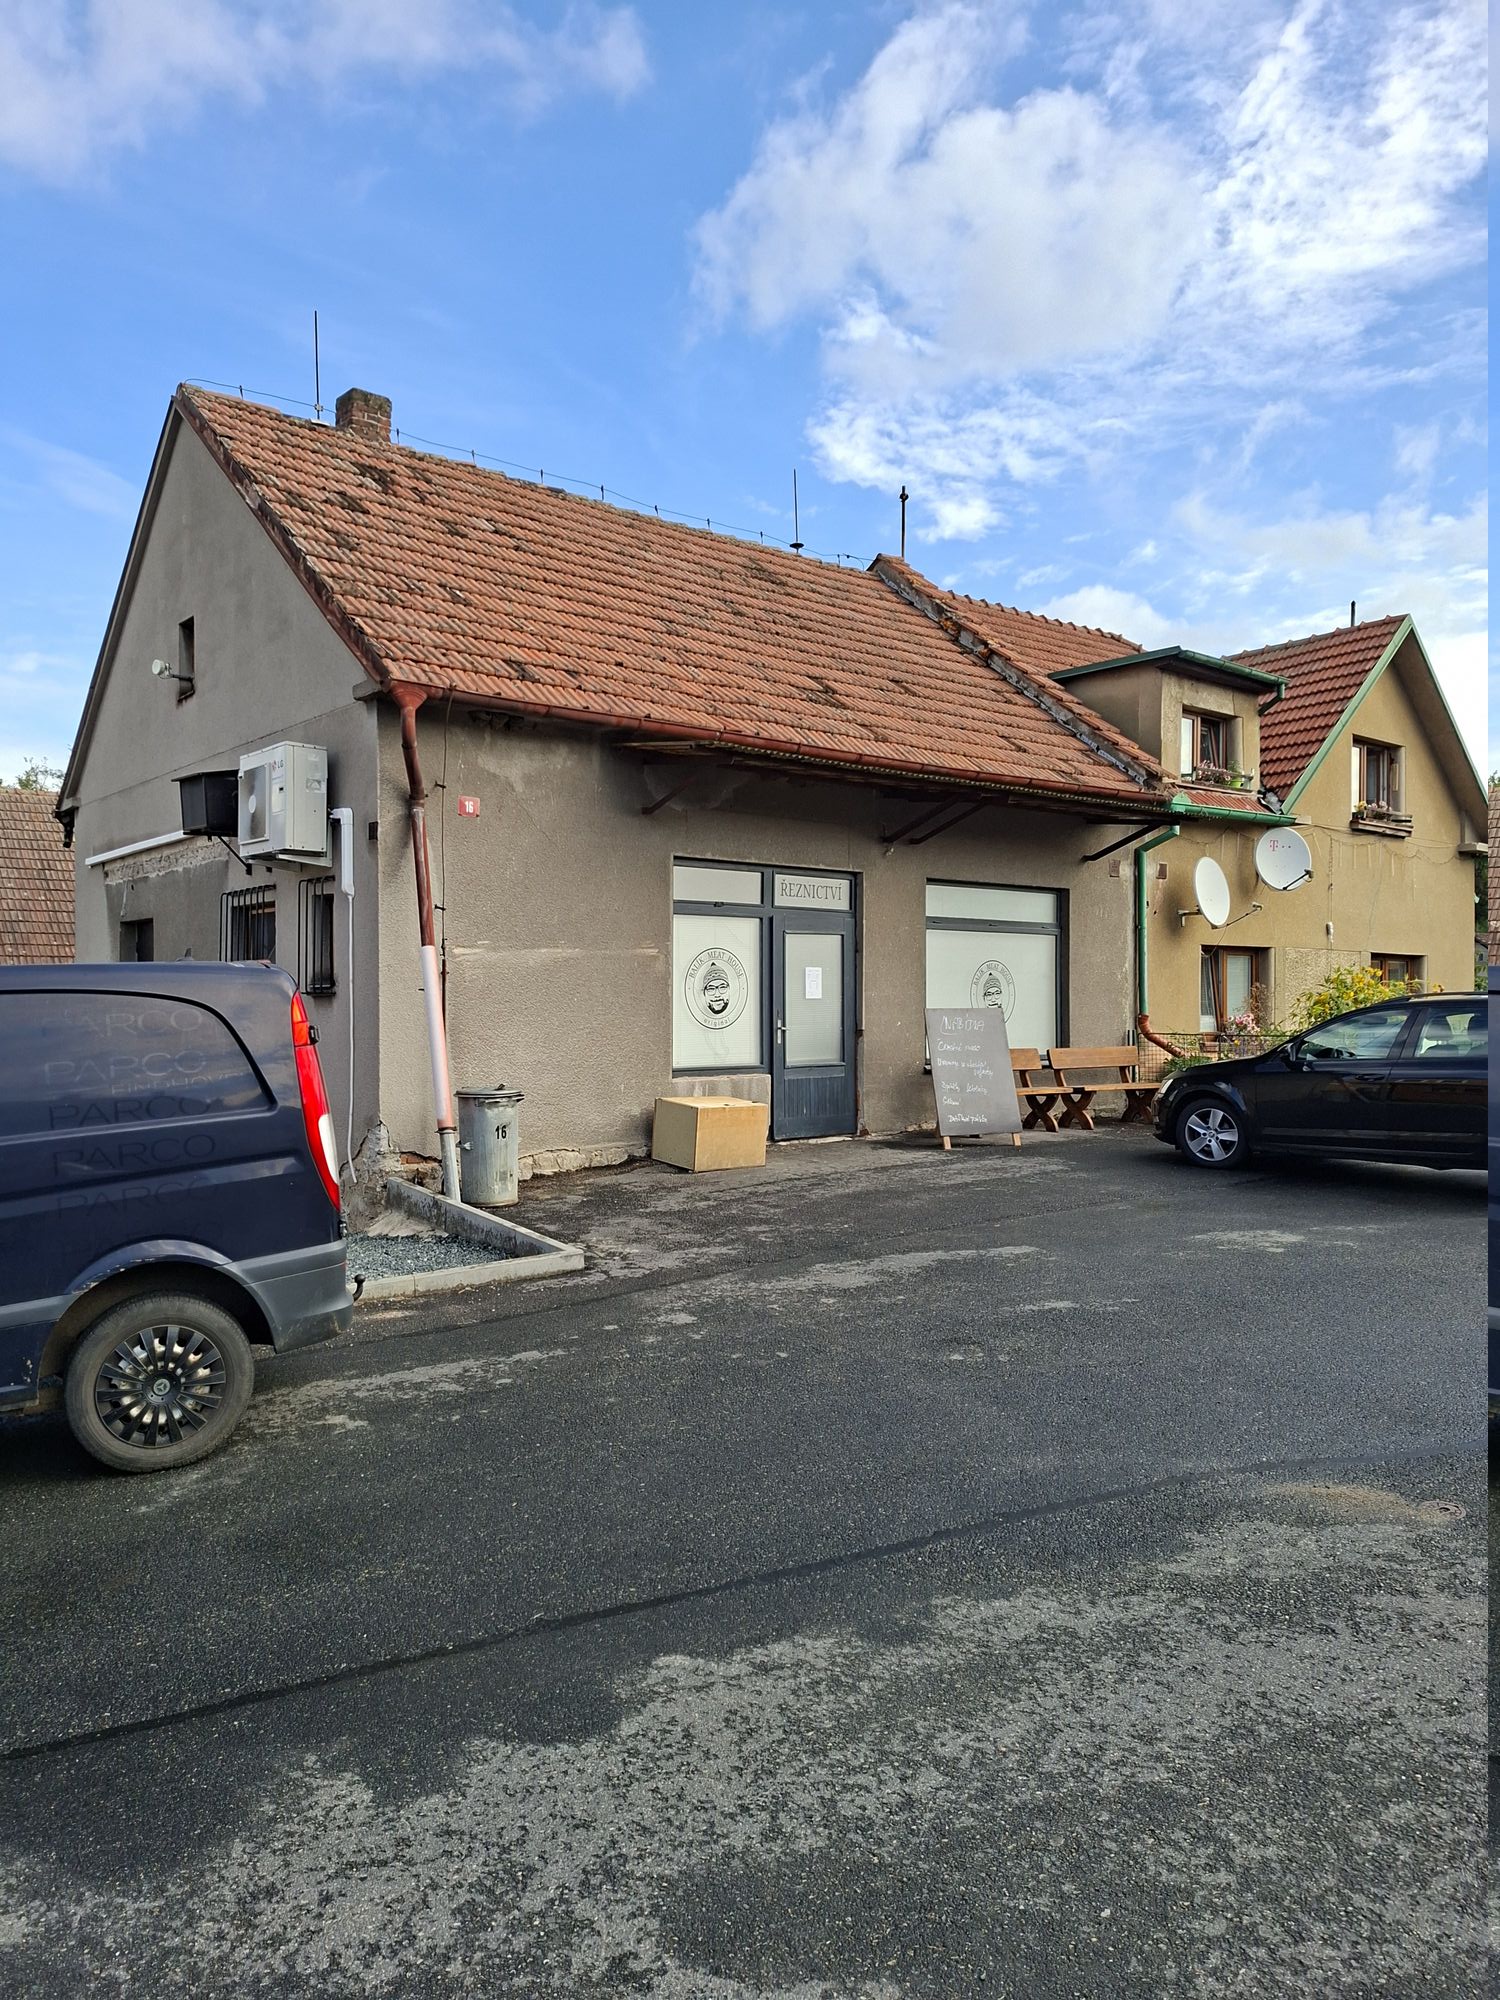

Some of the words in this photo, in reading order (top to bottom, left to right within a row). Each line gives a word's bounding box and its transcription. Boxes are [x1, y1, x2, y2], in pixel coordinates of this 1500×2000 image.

[277, 759, 285, 769] LG
[465, 800, 474, 813] 16
[780, 879, 843, 901] ŘEZNICTVÍ
[707, 950, 725, 960] MEAT
[727, 955, 744, 978] HOUSE
[44, 1051, 207, 1085] PARCO
[49, 1095, 211, 1130] PARCO
[495, 1124, 507, 1139] 16
[51, 1134, 216, 1177] PARCO
